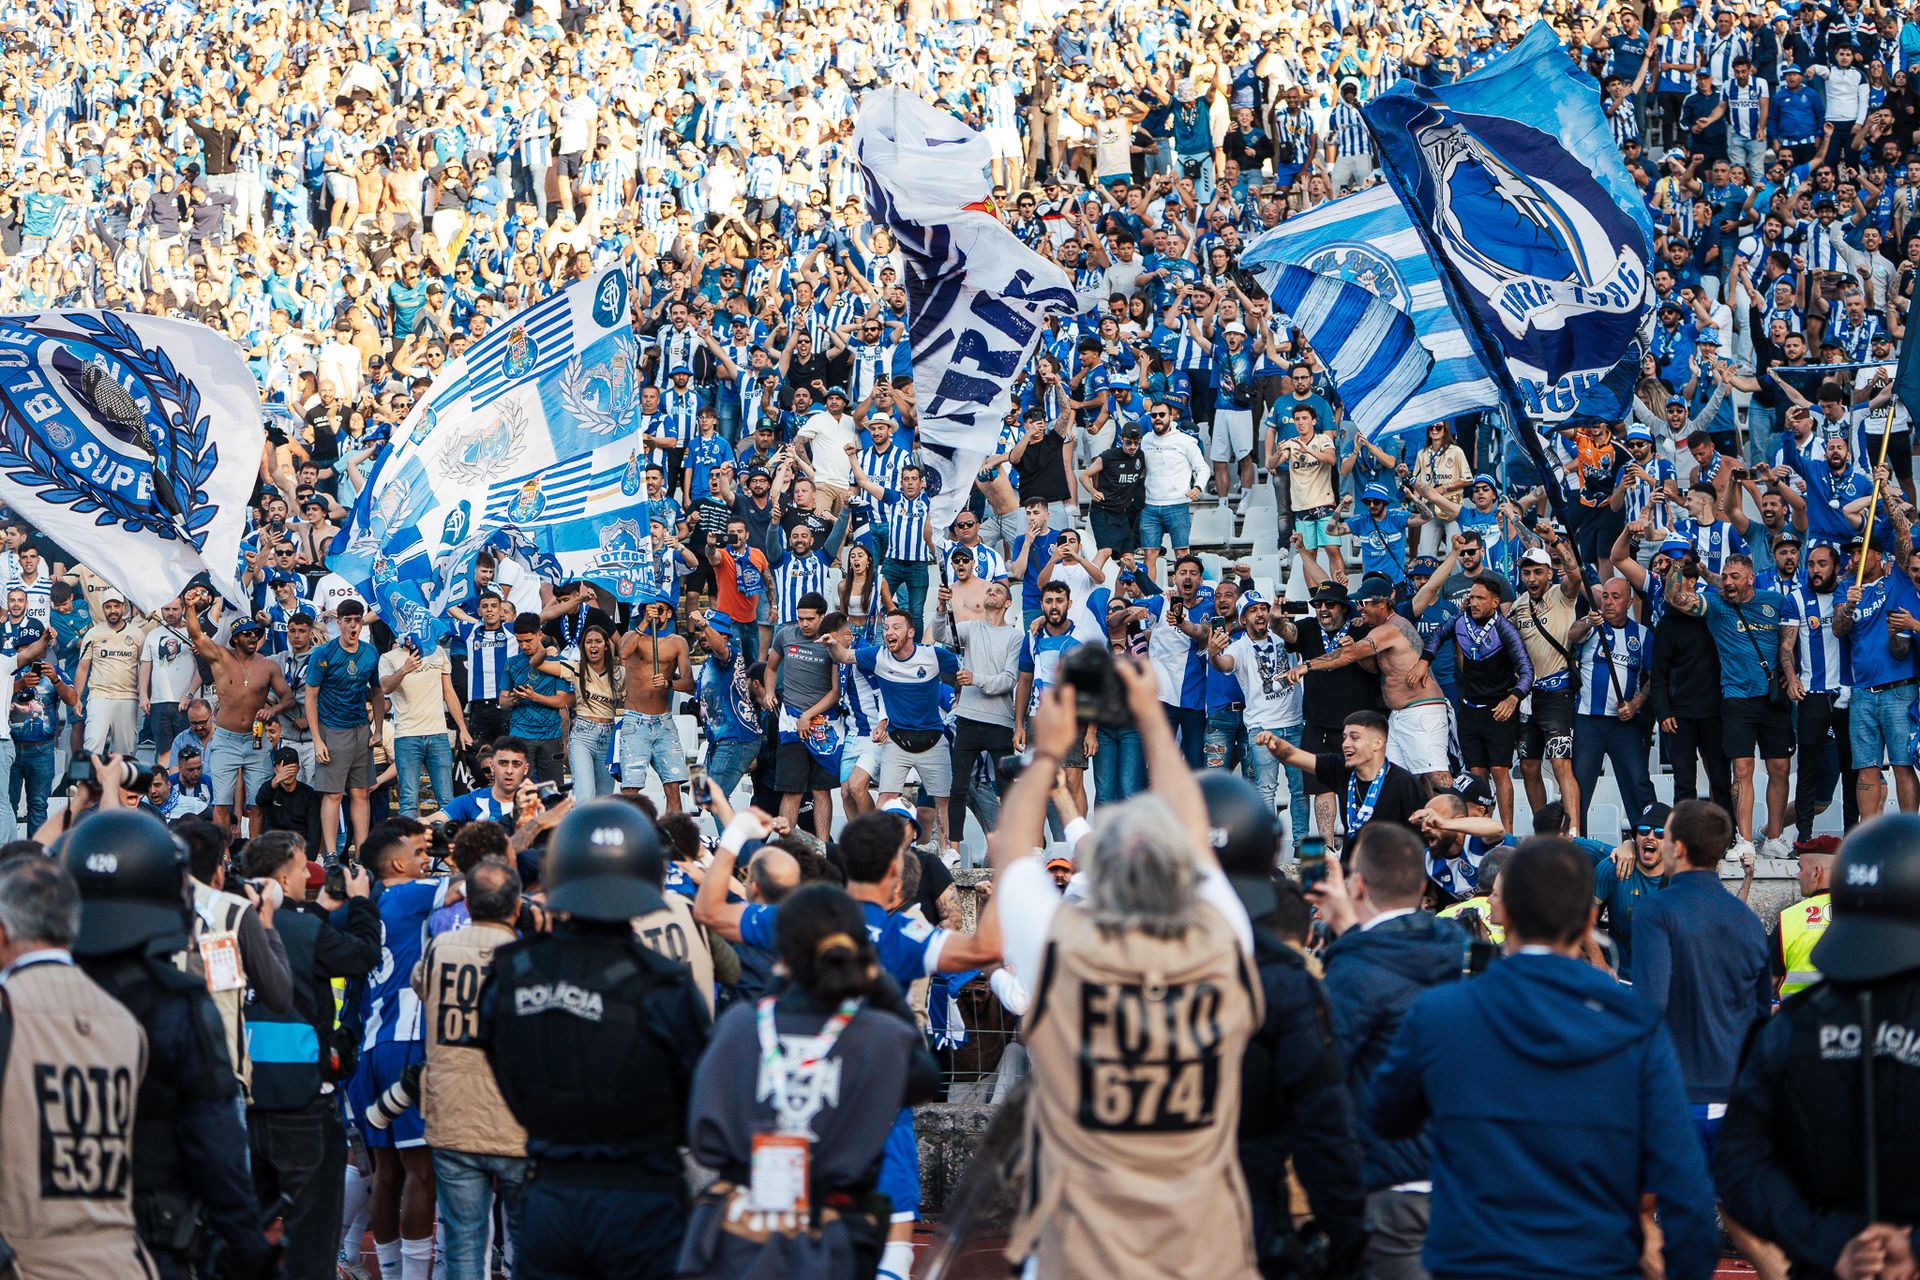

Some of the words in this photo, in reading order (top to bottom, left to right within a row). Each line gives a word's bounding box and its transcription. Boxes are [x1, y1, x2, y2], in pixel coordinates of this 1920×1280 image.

[70, 442, 156, 501] SUPE
[20, 628, 40, 638] 1986
[108, 650, 133, 658] BETANO
[514, 979, 604, 1014] POLÍCIA
[1081, 981, 1222, 1060] FOTO
[34, 1063, 131, 1136] FOTO
[1093, 1062, 1203, 1126] 674
[52, 1136, 126, 1192] 537
